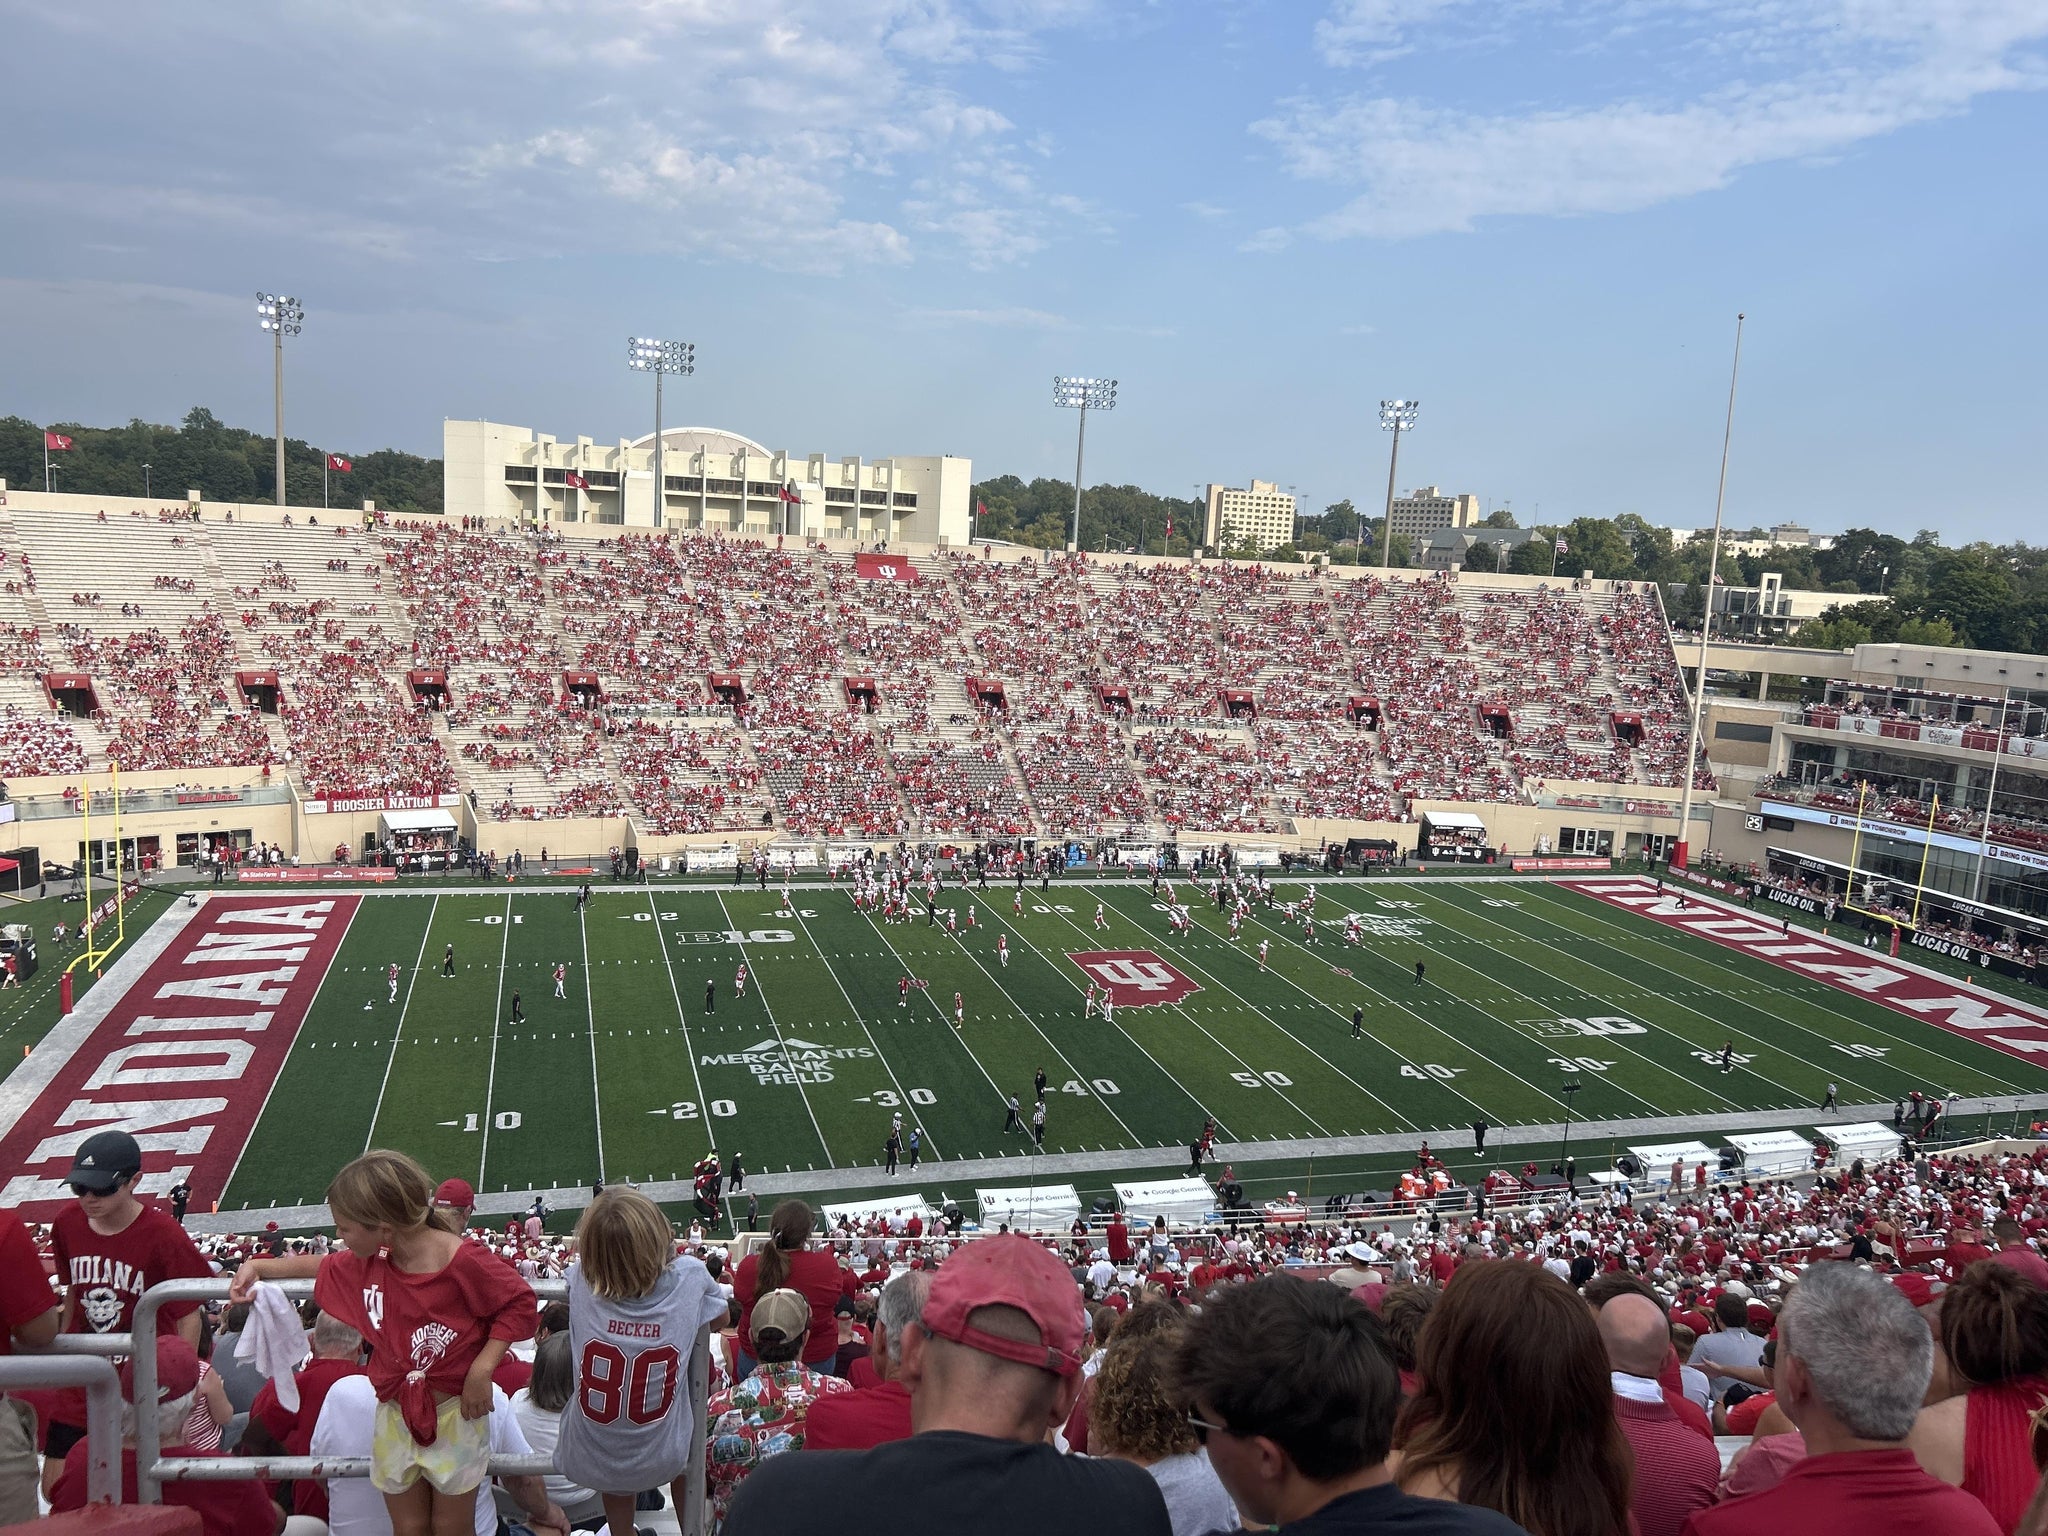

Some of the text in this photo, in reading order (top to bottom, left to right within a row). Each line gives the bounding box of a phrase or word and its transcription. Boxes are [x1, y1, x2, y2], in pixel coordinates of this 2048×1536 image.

[64, 680, 76, 688] 21
[254, 677, 265, 685] 22
[333, 796, 433, 812] HOOSIER NATION
[1638, 808, 1674, 816] TOMORROW
[1747, 816, 1760, 829] 25
[1840, 818, 1858, 828] BRING
[1871, 824, 1907, 836] TOMORROW
[2000, 850, 2020, 860] BRING
[1799, 858, 1826, 871] LUCAS OIL
[1768, 889, 1816, 913] LUCAS OIL
[1952, 901, 1985, 917] LUCAS OIL
[1910, 931, 1970, 961] LUCAS OIL
[1086, 960, 1175, 991] IU
[0, 900, 336, 1208] INDIANA
[700, 1047, 875, 1066] MERCHANTS
[1829, 1043, 1886, 1058] 10
[749, 1060, 834, 1075] BANK
[1400, 1063, 1457, 1080] 40
[1547, 1056, 1608, 1072] 30
[758, 1071, 835, 1085] FIELD
[1229, 1071, 1294, 1088] 50
[1061, 1078, 1121, 1096] 40
[872, 1088, 938, 1107] 30
[671, 1099, 738, 1119] 20
[463, 1111, 522, 1131] 10
[1014, 1195, 1044, 1203] Google
[1045, 1193, 1075, 1201] Gemini
[69, 1255, 145, 1296] NDIANA
[607, 1319, 661, 1338] BECKER
[578, 1338, 681, 1426] 80
